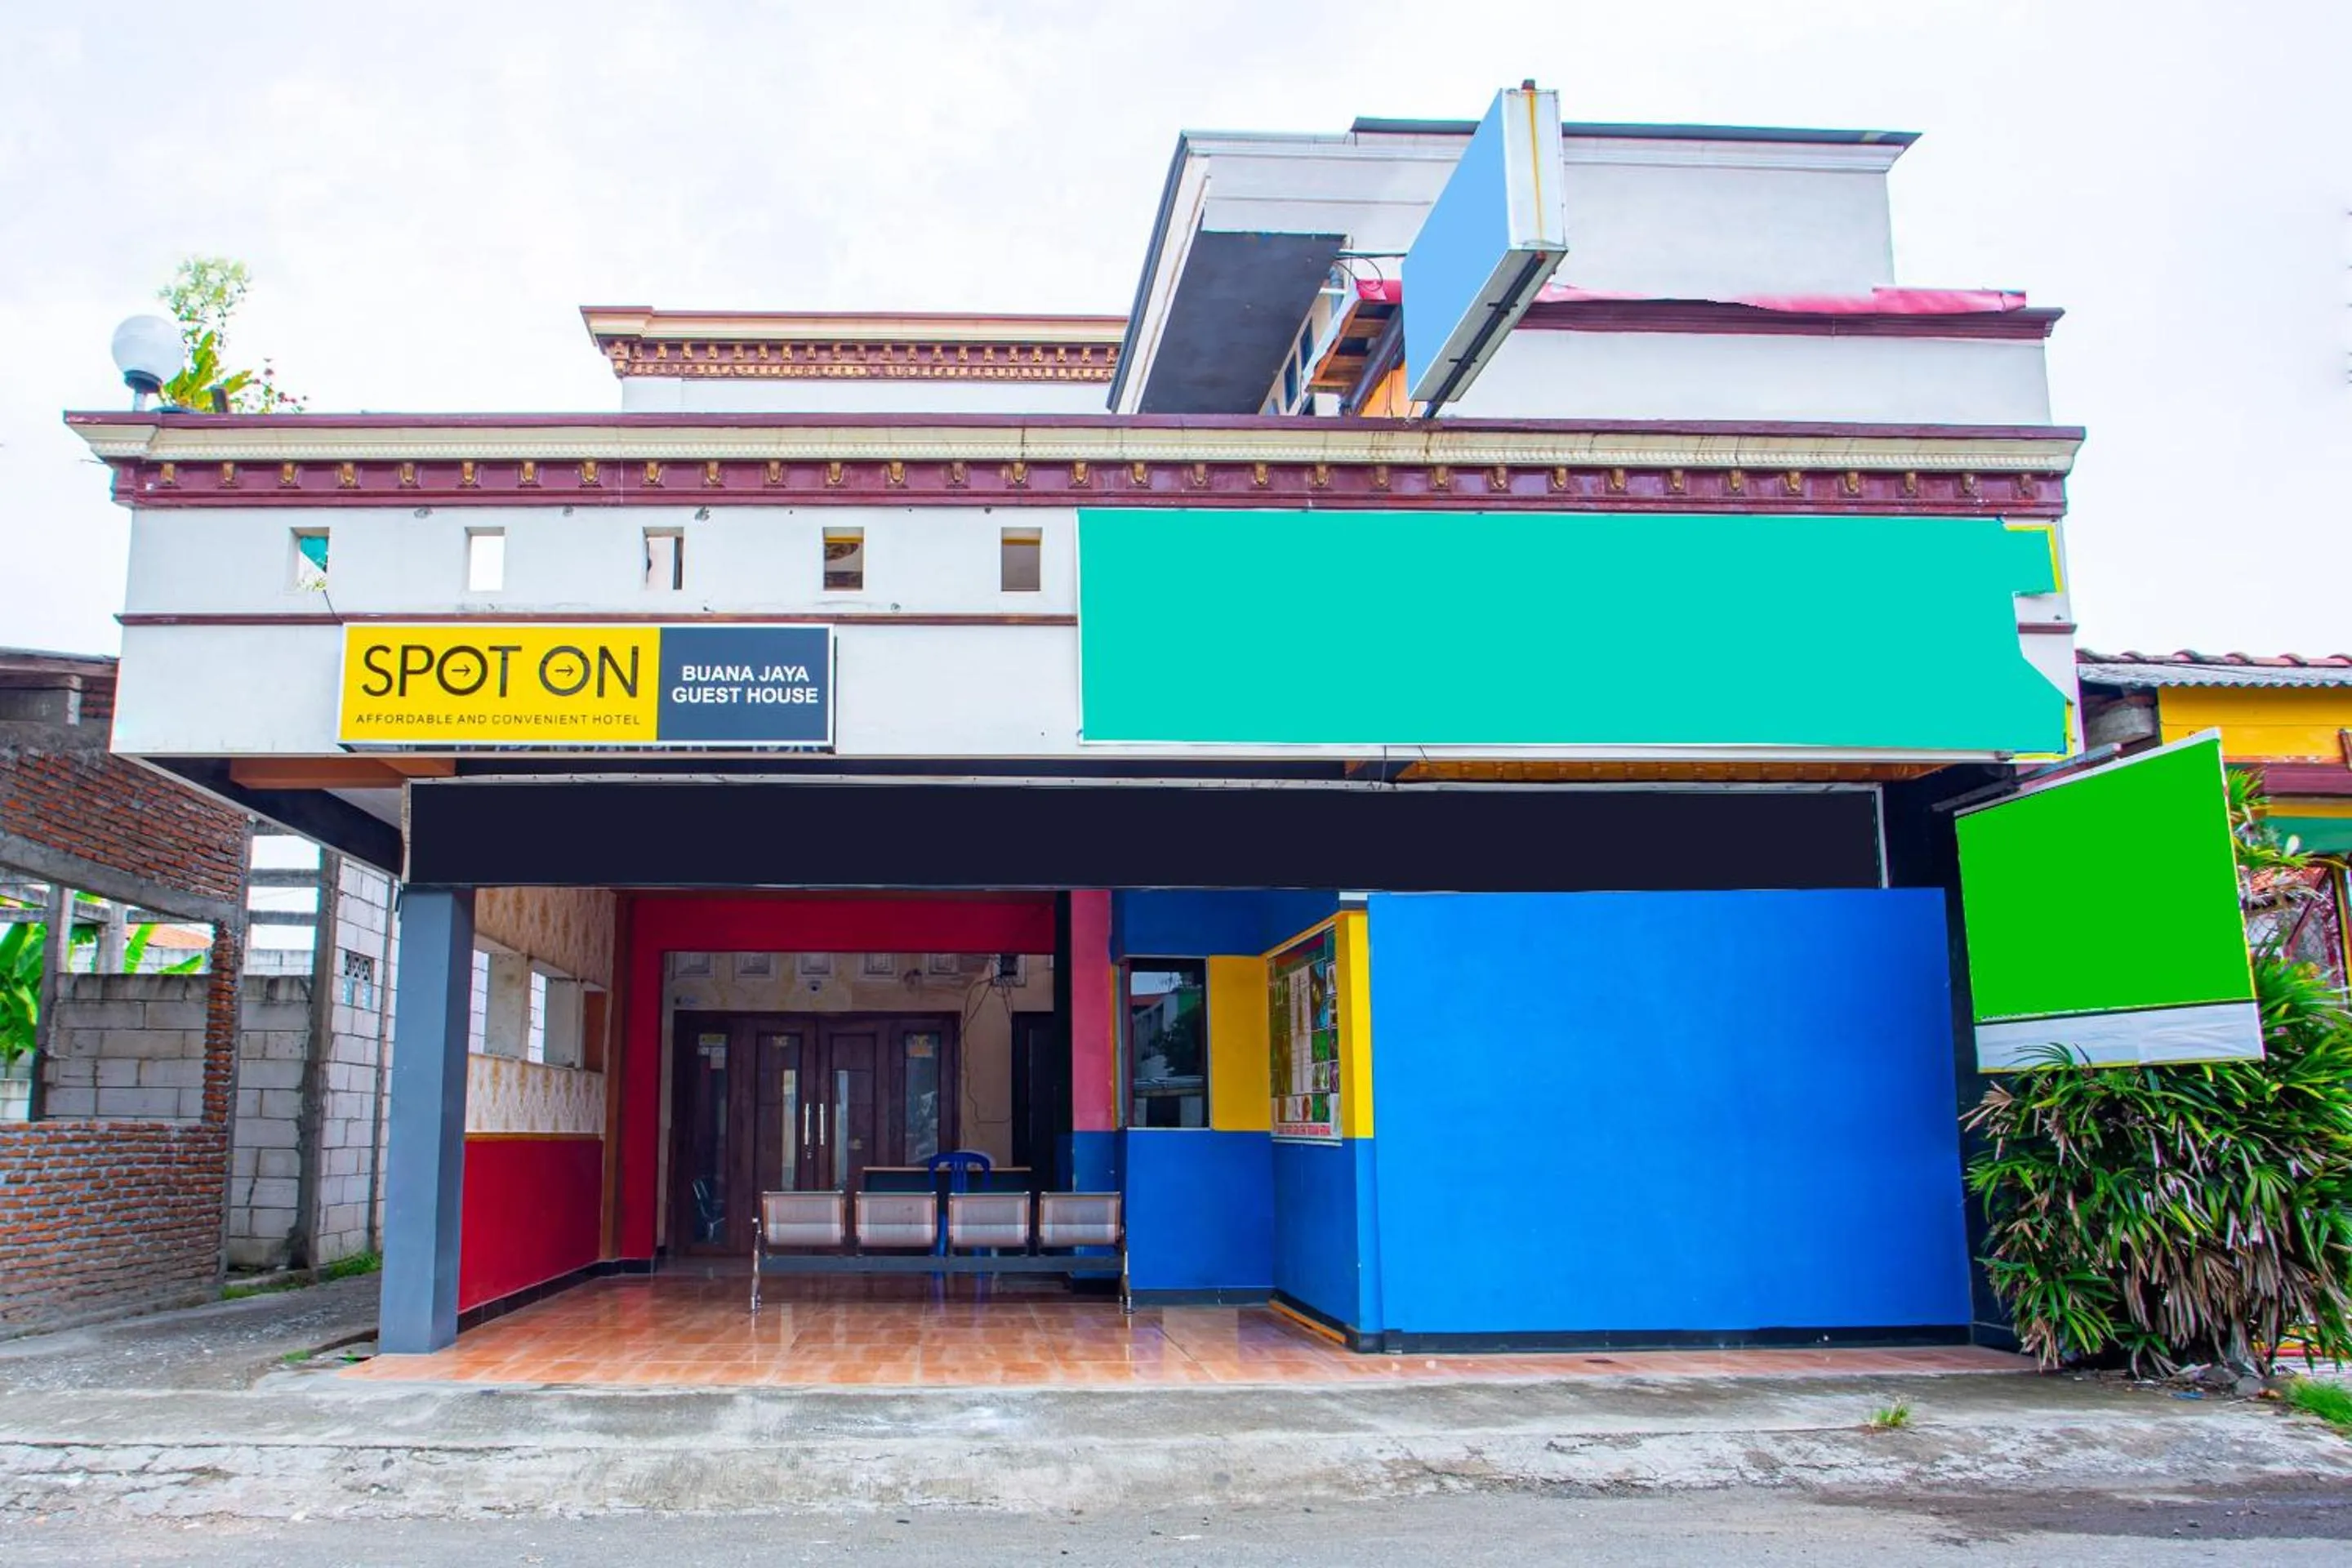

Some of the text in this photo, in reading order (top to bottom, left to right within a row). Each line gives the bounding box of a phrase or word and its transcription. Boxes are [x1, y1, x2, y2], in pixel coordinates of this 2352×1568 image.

[361, 644, 639, 699] SPOT ON
[681, 665, 810, 683] BUANA JAYA
[671, 686, 818, 704] GUEST HOUSE
[356, 713, 640, 725] AFFORDABLE AND CONVENIENT HOTEL
